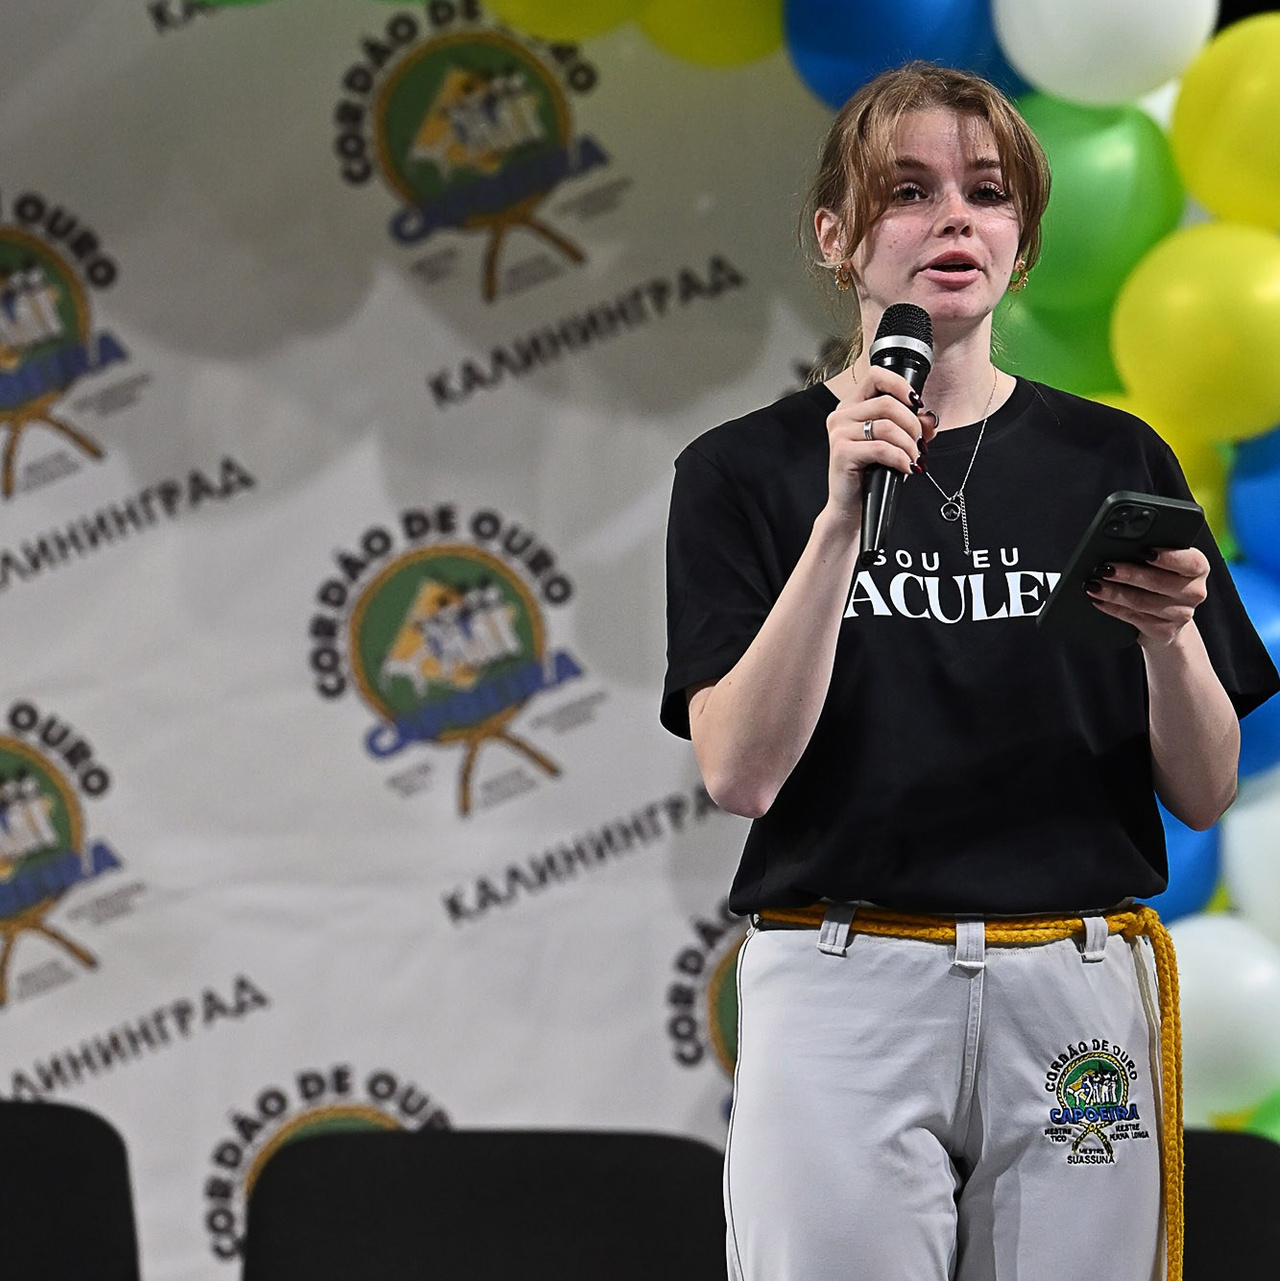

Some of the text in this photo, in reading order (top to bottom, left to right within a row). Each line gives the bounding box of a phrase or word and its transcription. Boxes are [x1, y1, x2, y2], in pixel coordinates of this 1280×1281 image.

[402, 505, 454, 540] DE
[471, 510, 572, 605] OURO
[872, 547, 1019, 572] SOU EU
[9, 702, 110, 797] OURO
[442, 782, 720, 928] КАЛИНИНГРА
[3, 975, 270, 1101] ЛИНИНГРАД
[1092, 1038, 1109, 1052] DE
[296, 1064, 352, 1100] DE
[1050, 1103, 1140, 1125] CAPOEIRA
[1067, 1154, 1116, 1165] SUASSUNA
